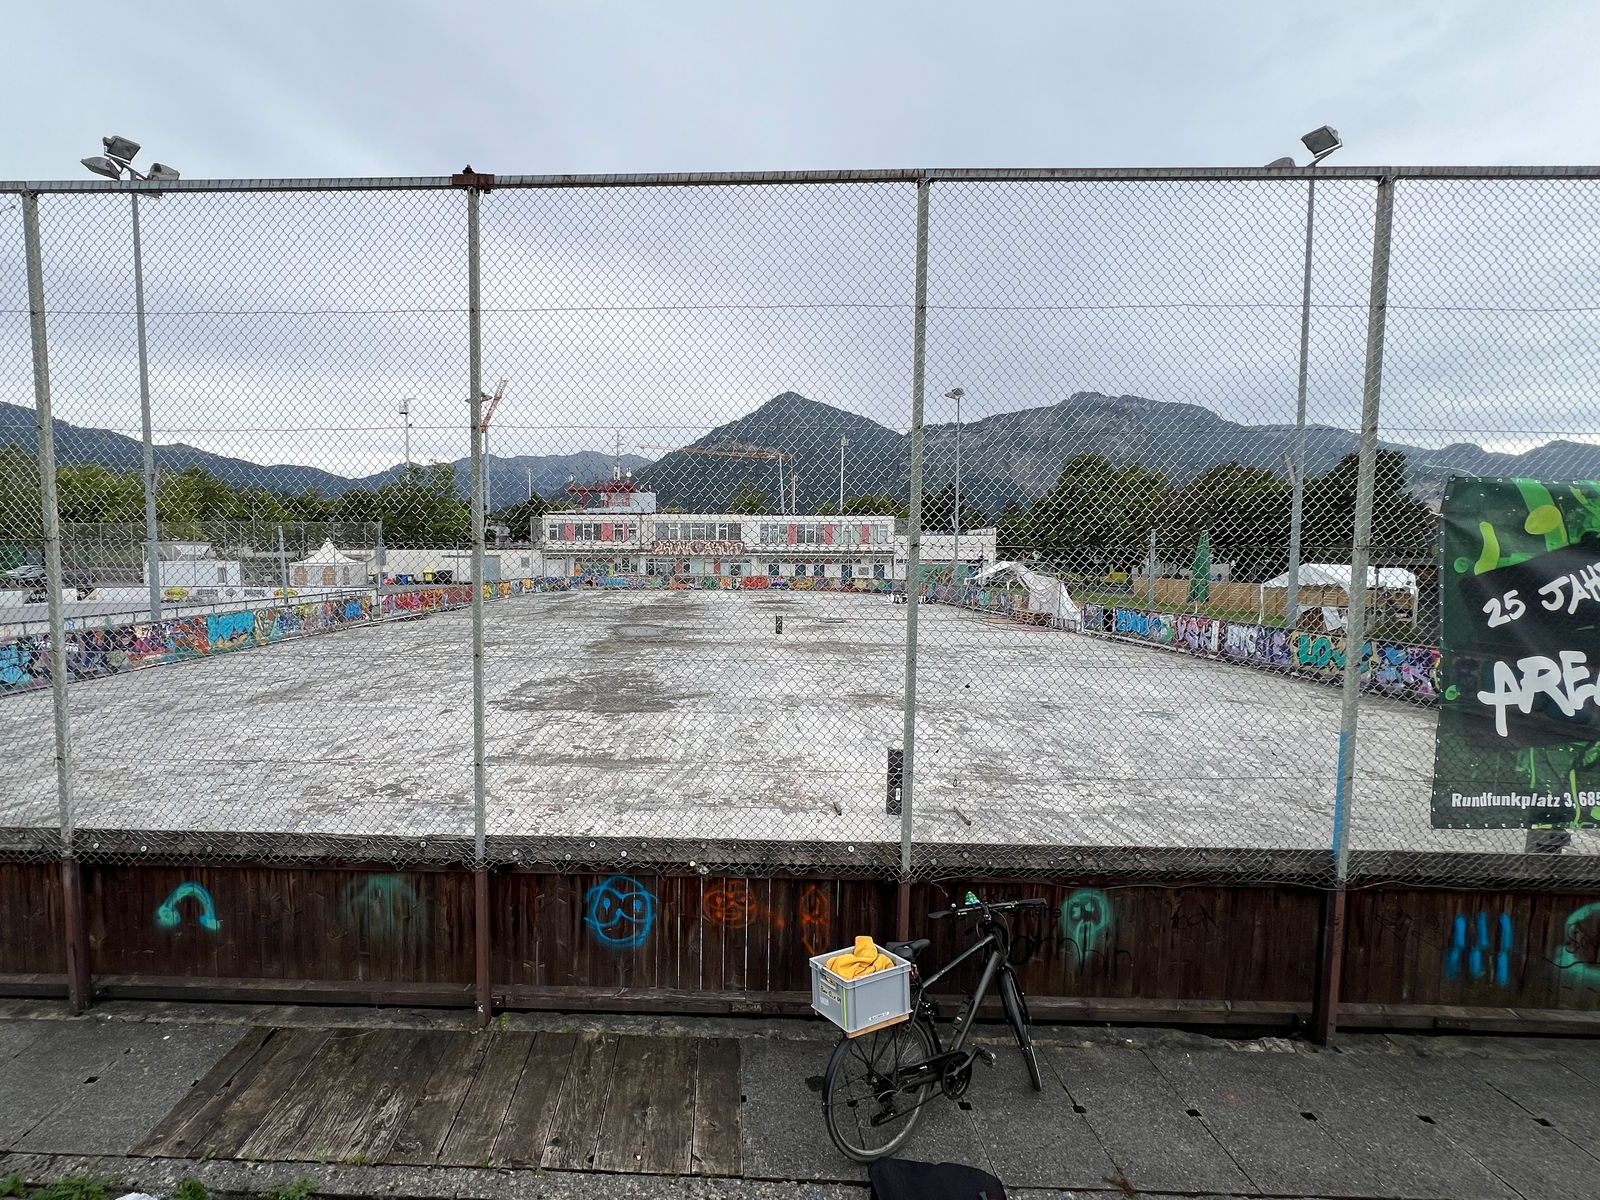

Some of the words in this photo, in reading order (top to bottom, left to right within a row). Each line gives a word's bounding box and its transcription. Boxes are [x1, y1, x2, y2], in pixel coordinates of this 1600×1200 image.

[1482, 589, 1527, 629] 25
[1476, 650, 1600, 737] ARE
[1451, 791, 1561, 810] Rundfunkplatz
